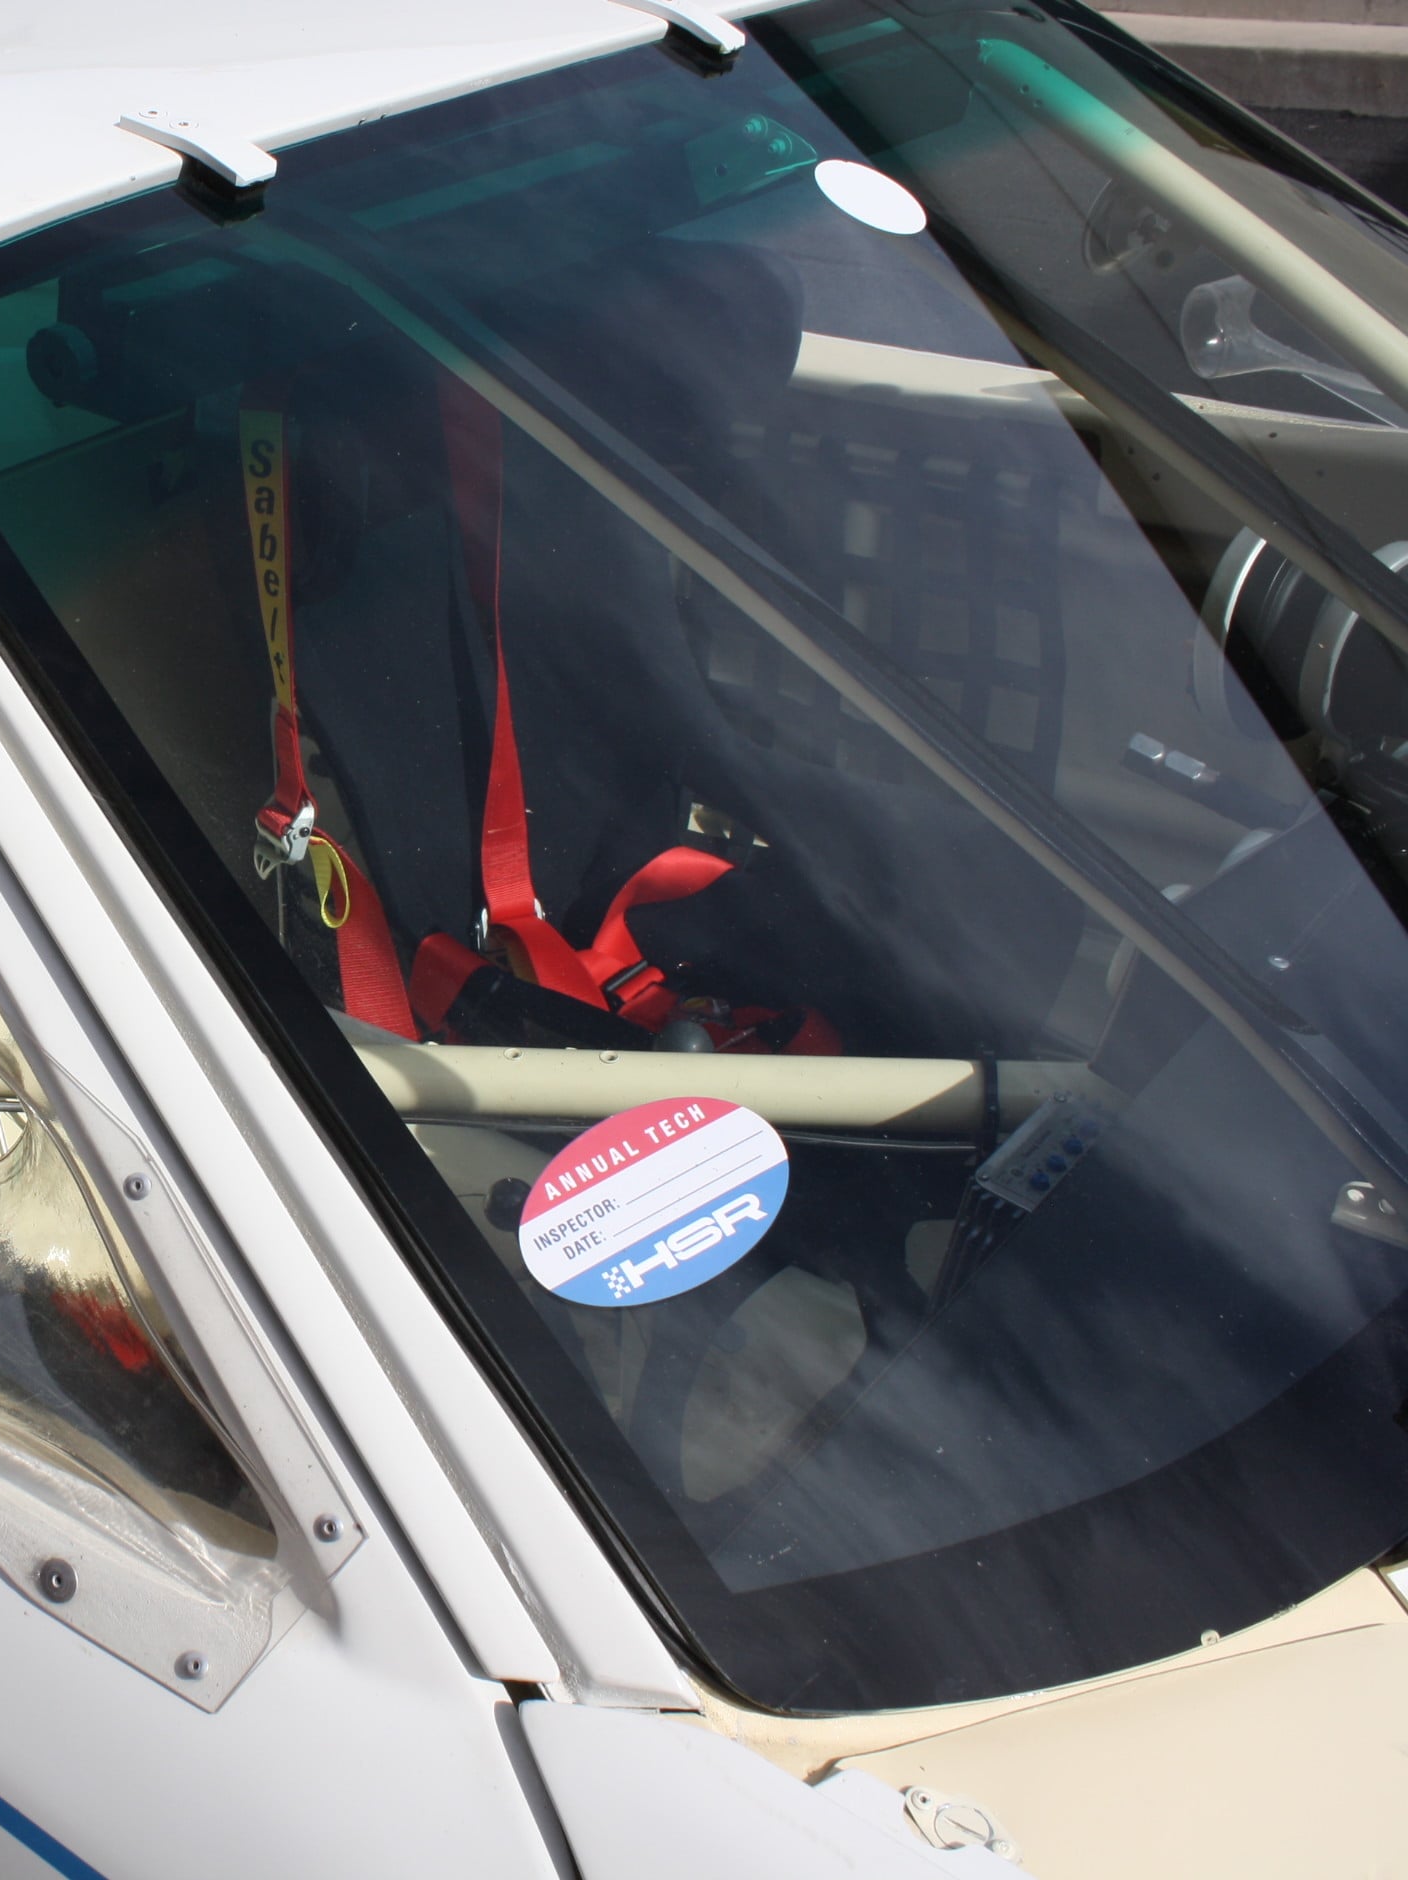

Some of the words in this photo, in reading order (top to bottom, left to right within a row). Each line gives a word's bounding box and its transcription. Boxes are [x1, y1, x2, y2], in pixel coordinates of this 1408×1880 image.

[248, 438, 285, 685] Sabelt
[543, 1140, 640, 1201] ANNUAL
[644, 1103, 707, 1145] TECH
[533, 1196, 621, 1252] INSPECTOR:
[562, 1230, 608, 1261] DATE:
[619, 1193, 769, 1289] HSR
